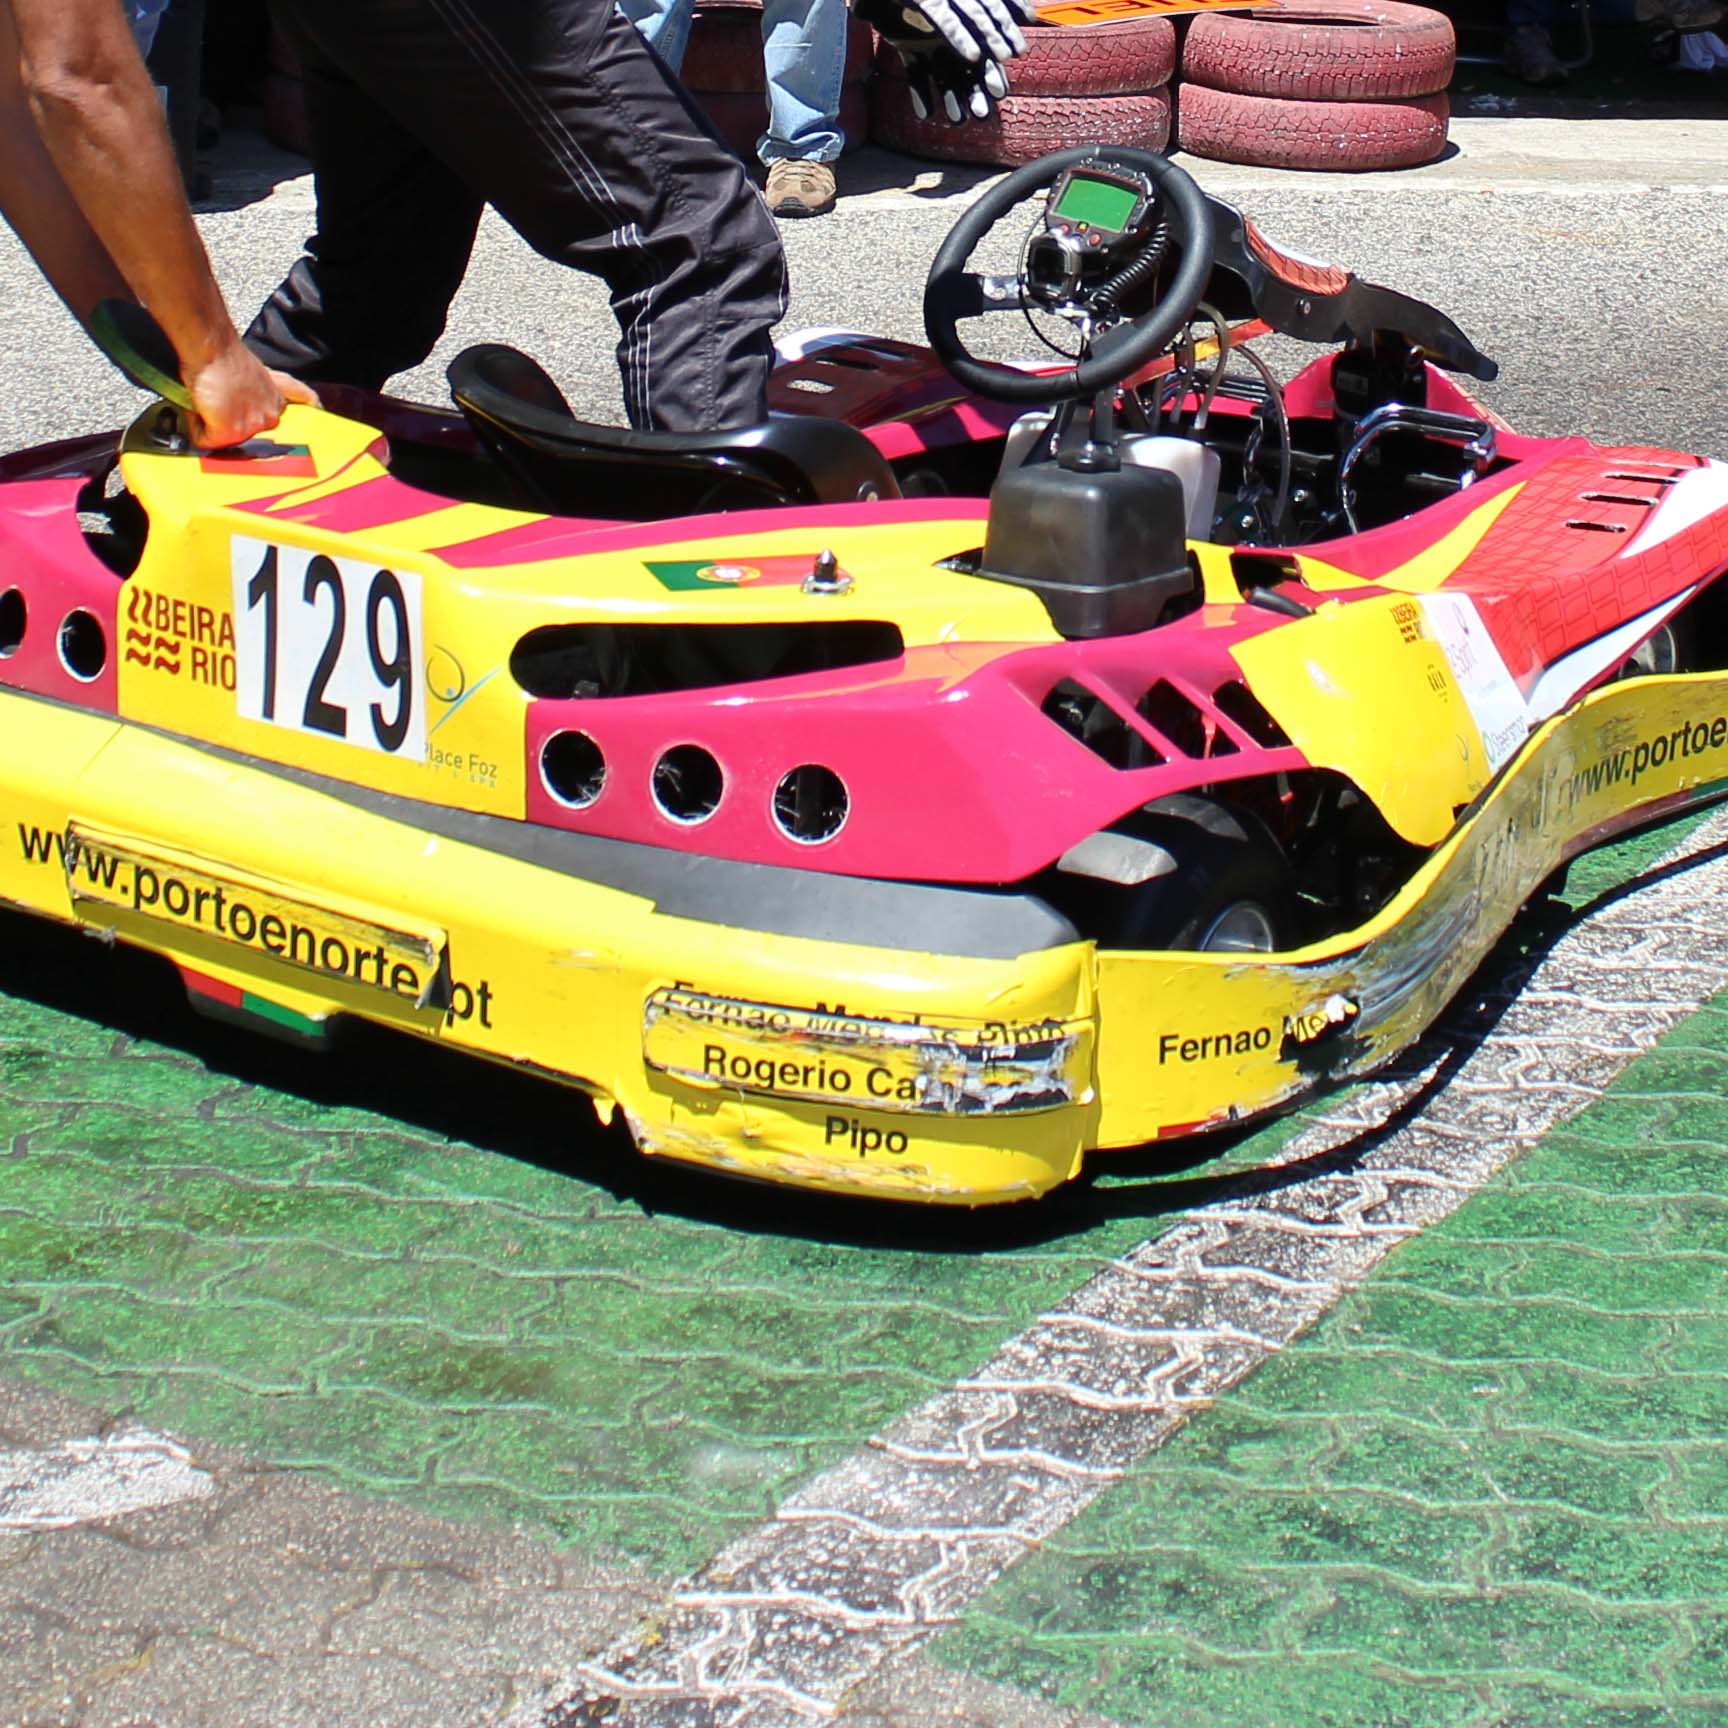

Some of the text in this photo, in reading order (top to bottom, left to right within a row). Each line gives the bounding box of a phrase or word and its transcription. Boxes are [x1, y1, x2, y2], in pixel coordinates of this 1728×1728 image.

[154, 593, 237, 652] BEIRA
[191, 646, 237, 692] RIO
[246, 545, 413, 753] 129
[468, 753, 497, 779] Foz
[703, 1044, 852, 1093] Rogerio
[1159, 1026, 1271, 1065] Fernao
[824, 1115, 909, 1158] Pipo
